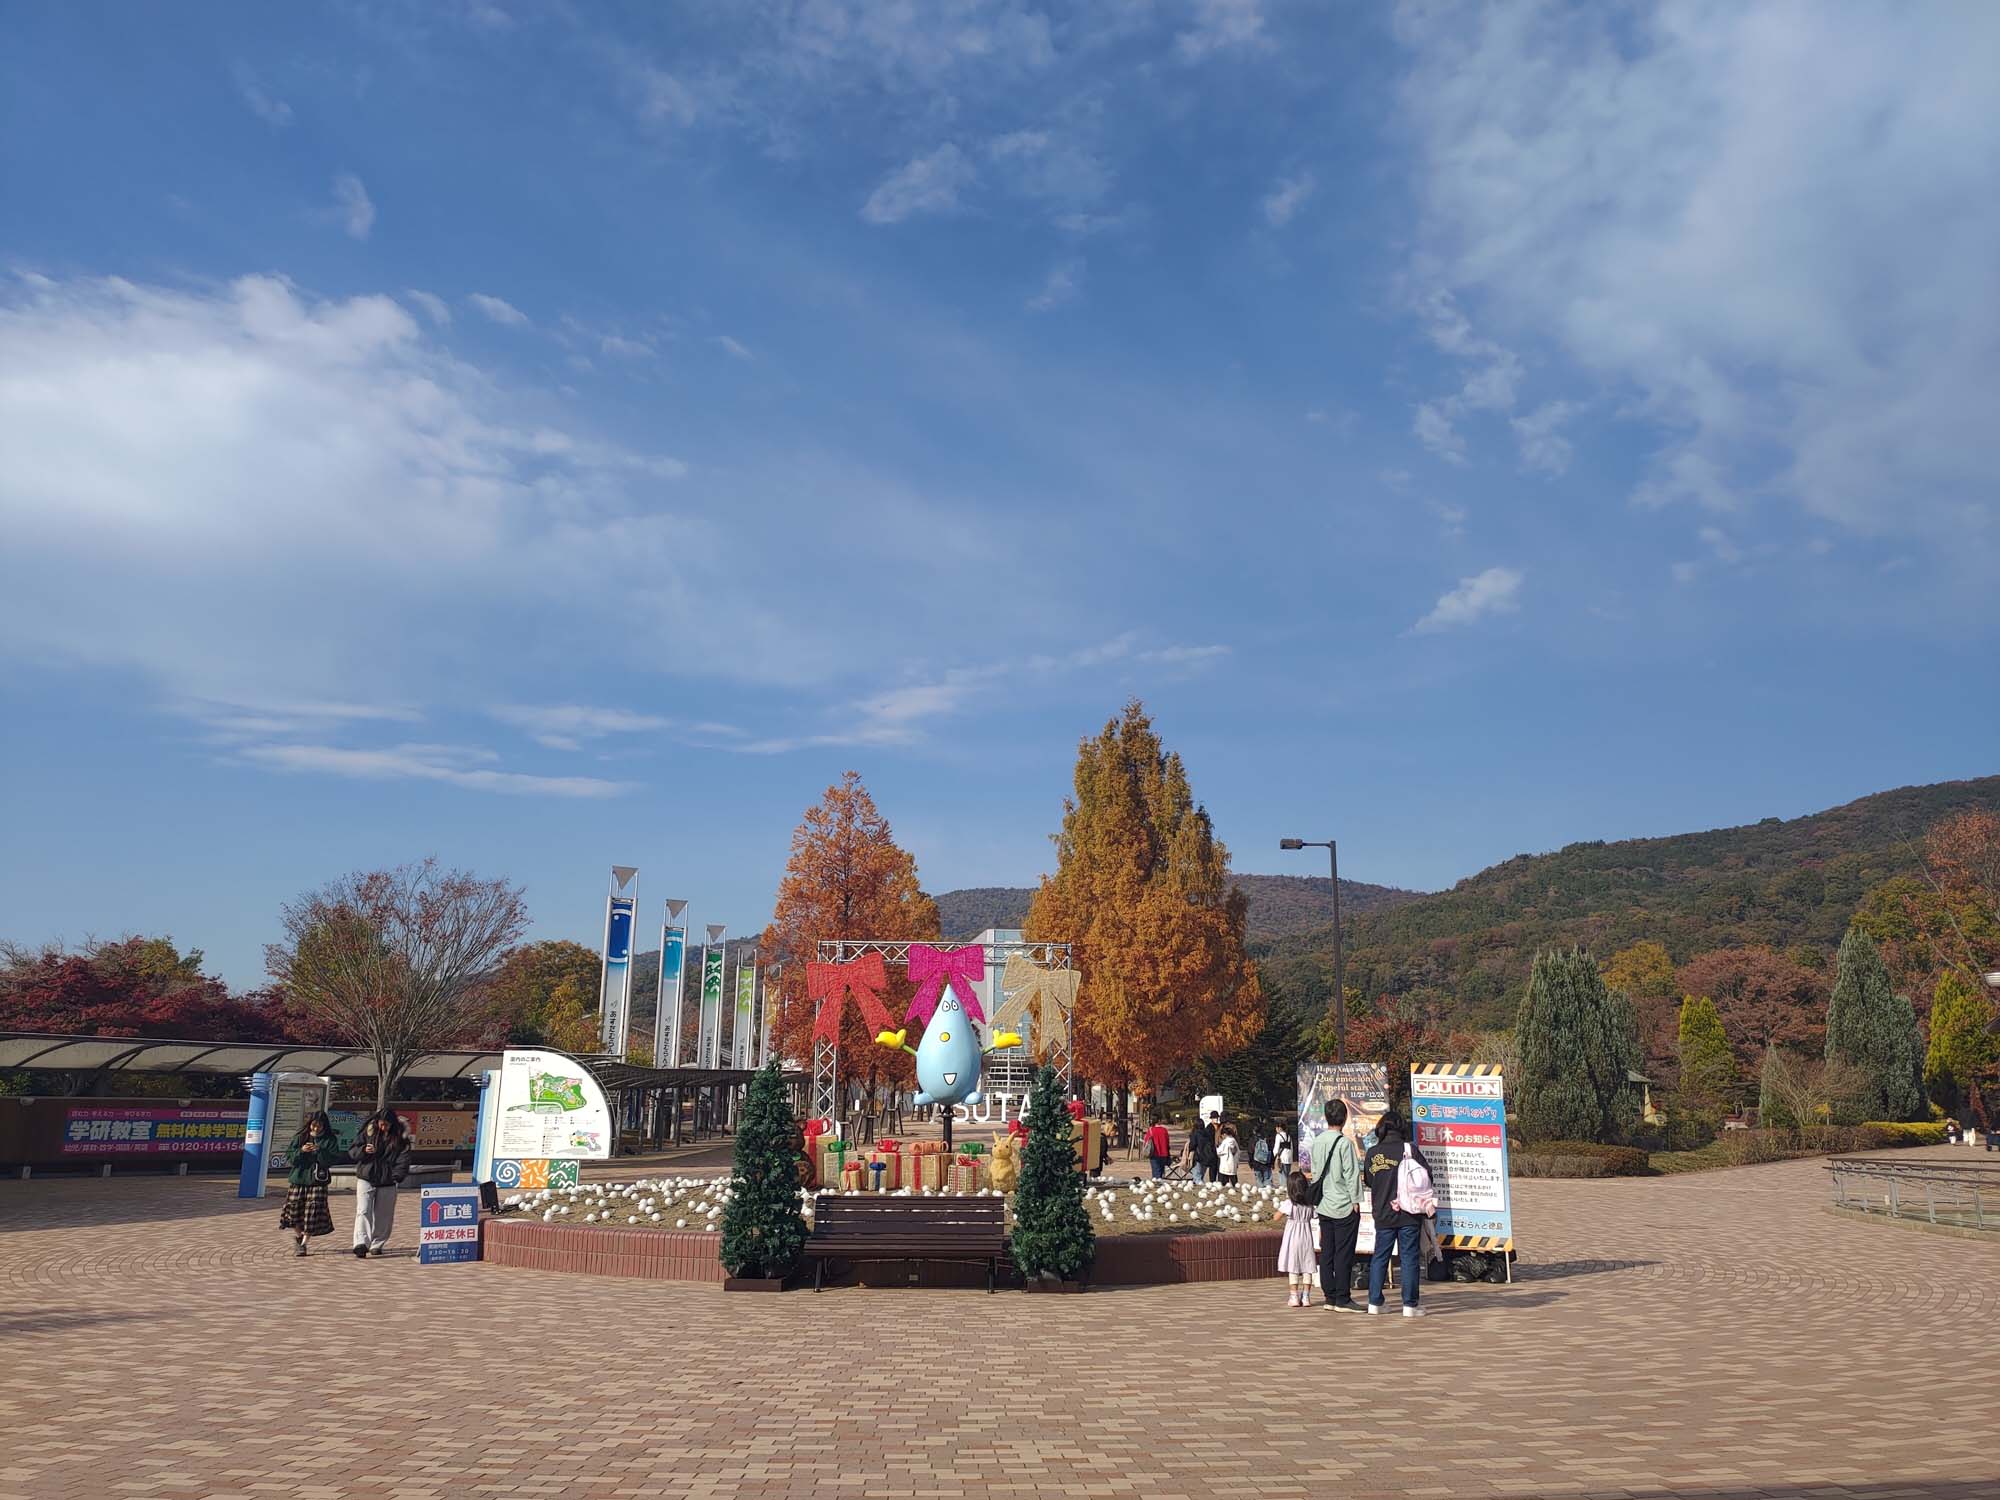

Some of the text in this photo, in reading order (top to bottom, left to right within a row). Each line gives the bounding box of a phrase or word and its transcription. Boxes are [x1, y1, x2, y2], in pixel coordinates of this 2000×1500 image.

[1416, 1080, 1498, 1095] CAUTION
[68, 1120, 152, 1141] 学研教室
[1421, 1126, 1500, 1145] 運休のお知らせ
[443, 1203, 472, 1220] 直進
[424, 1228, 476, 1241] 水曜定休日
